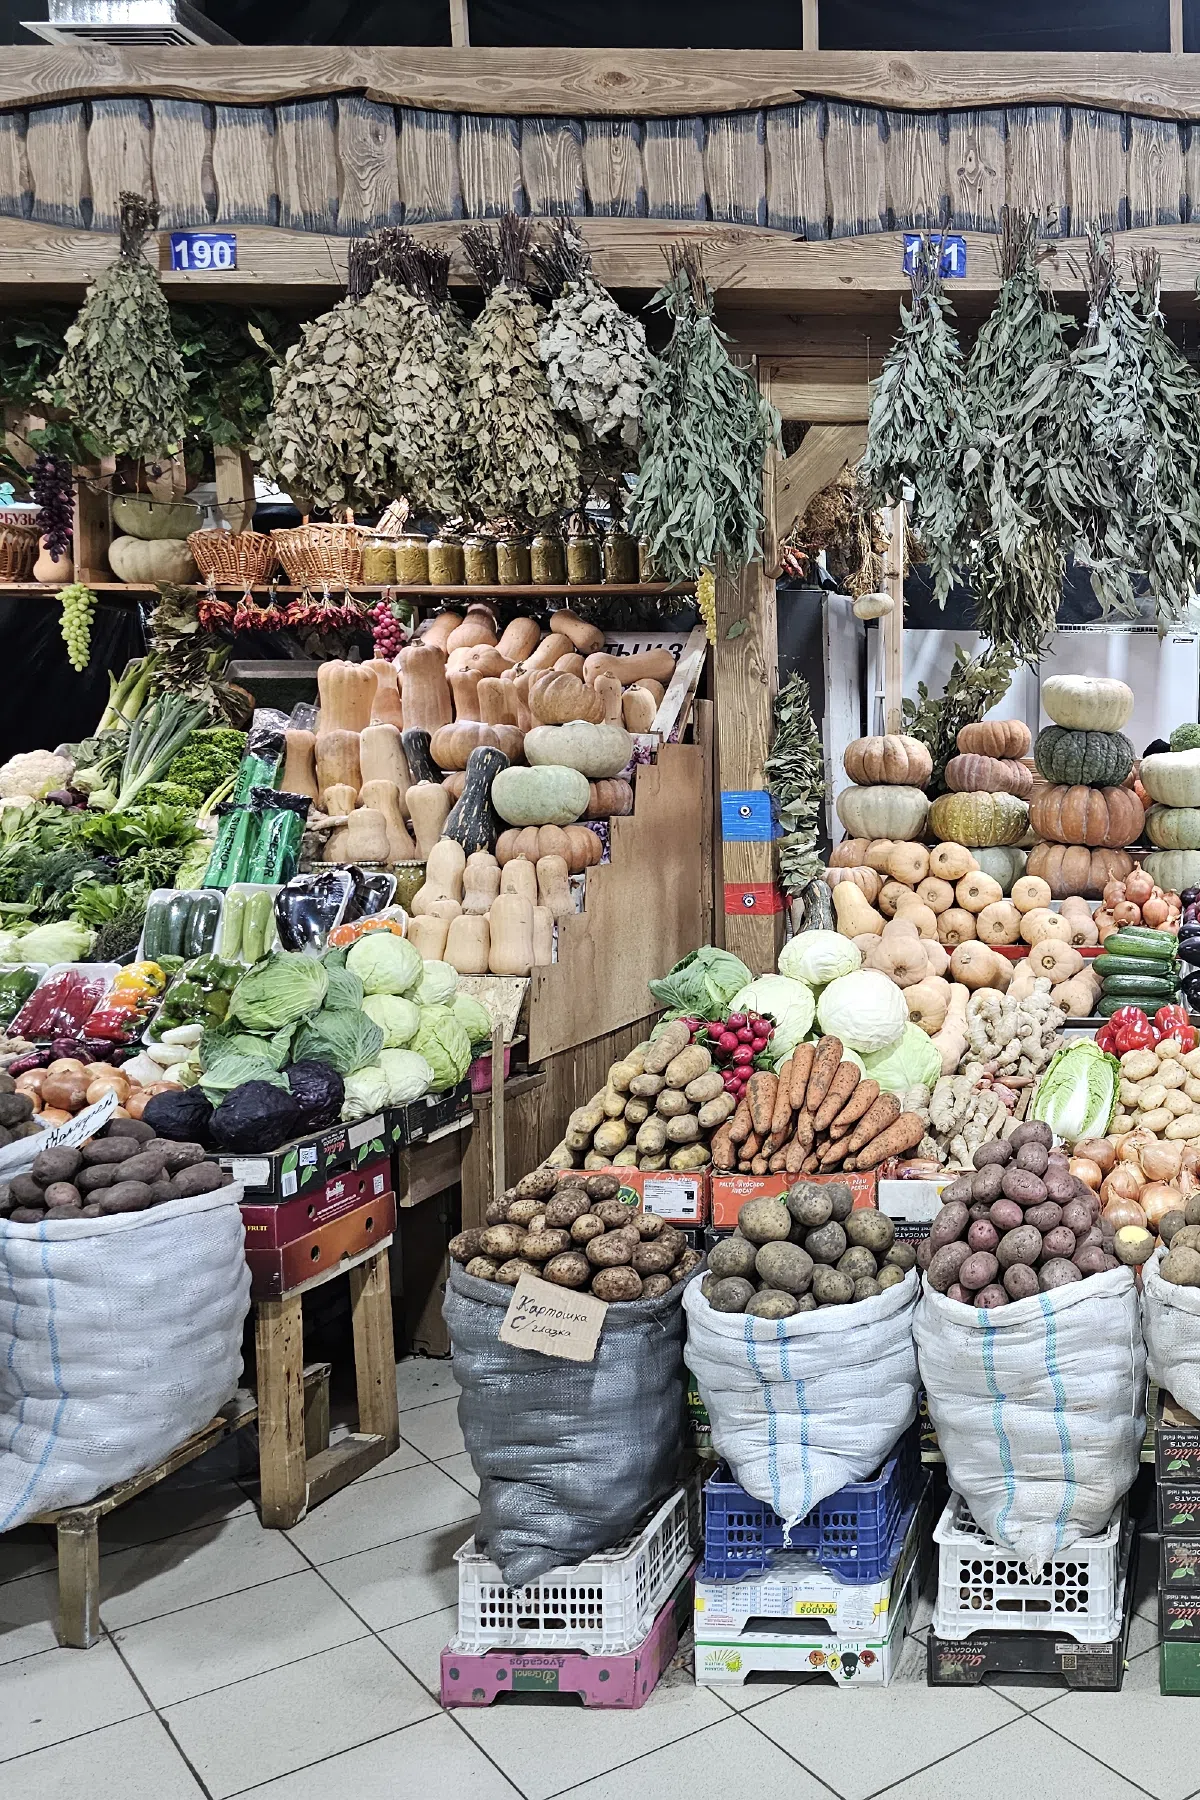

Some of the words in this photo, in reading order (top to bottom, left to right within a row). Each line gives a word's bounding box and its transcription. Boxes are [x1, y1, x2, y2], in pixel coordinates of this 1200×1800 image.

[175, 240, 231, 268] 190
[234, 770, 248, 805] SUPE
[516, 1295, 588, 1322] Картошка
[509, 1658, 566, 1667] Avocados
